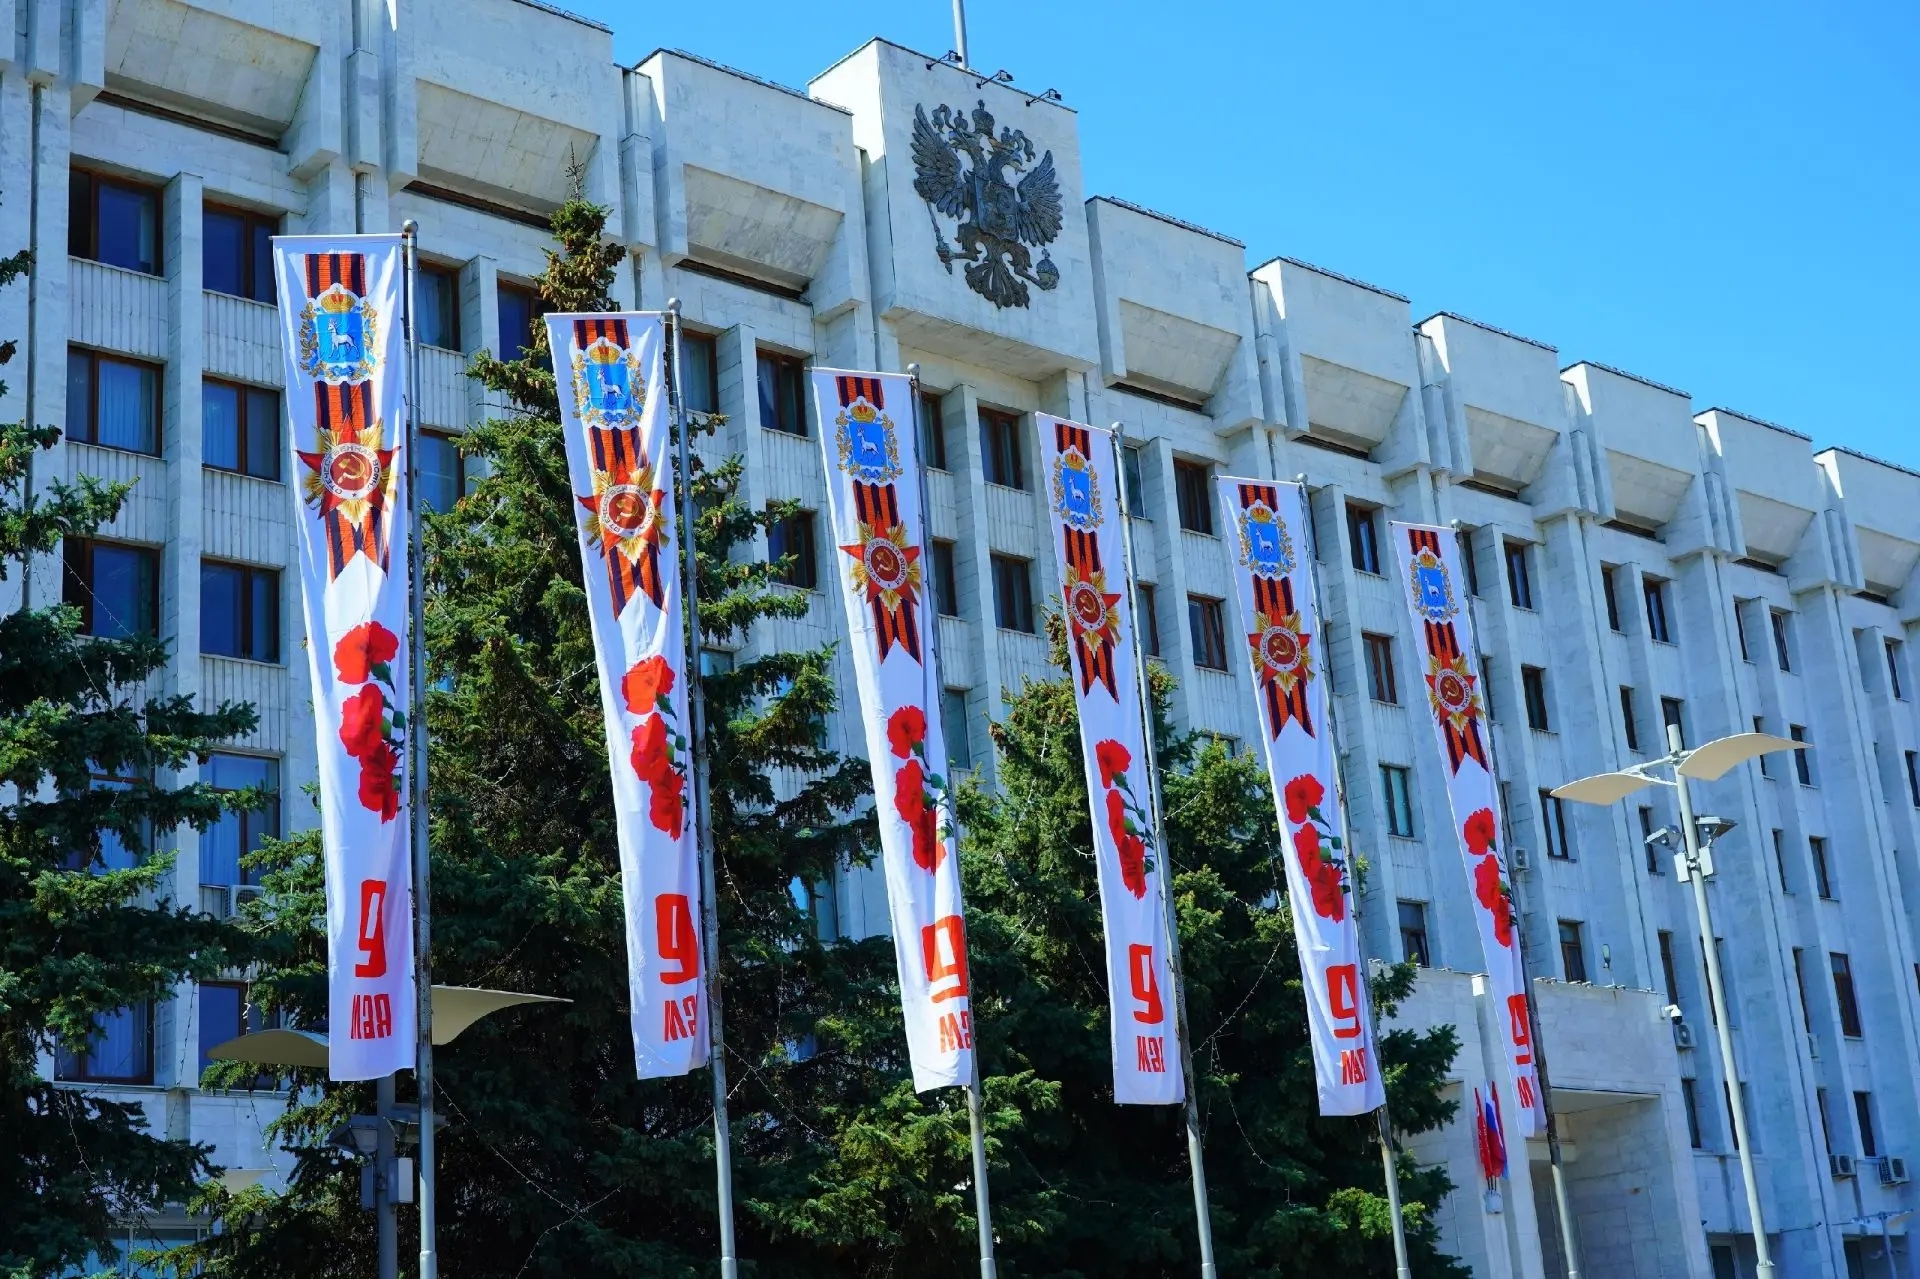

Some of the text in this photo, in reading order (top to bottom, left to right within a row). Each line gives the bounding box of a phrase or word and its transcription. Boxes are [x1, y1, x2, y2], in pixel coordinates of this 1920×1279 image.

[355, 879, 387, 978] 9
[655, 893, 698, 985] 9
[921, 915, 968, 1003] 9
[1129, 943, 1164, 1024] 9
[1326, 964, 1361, 1038] 9
[1507, 994, 1531, 1065] 9
